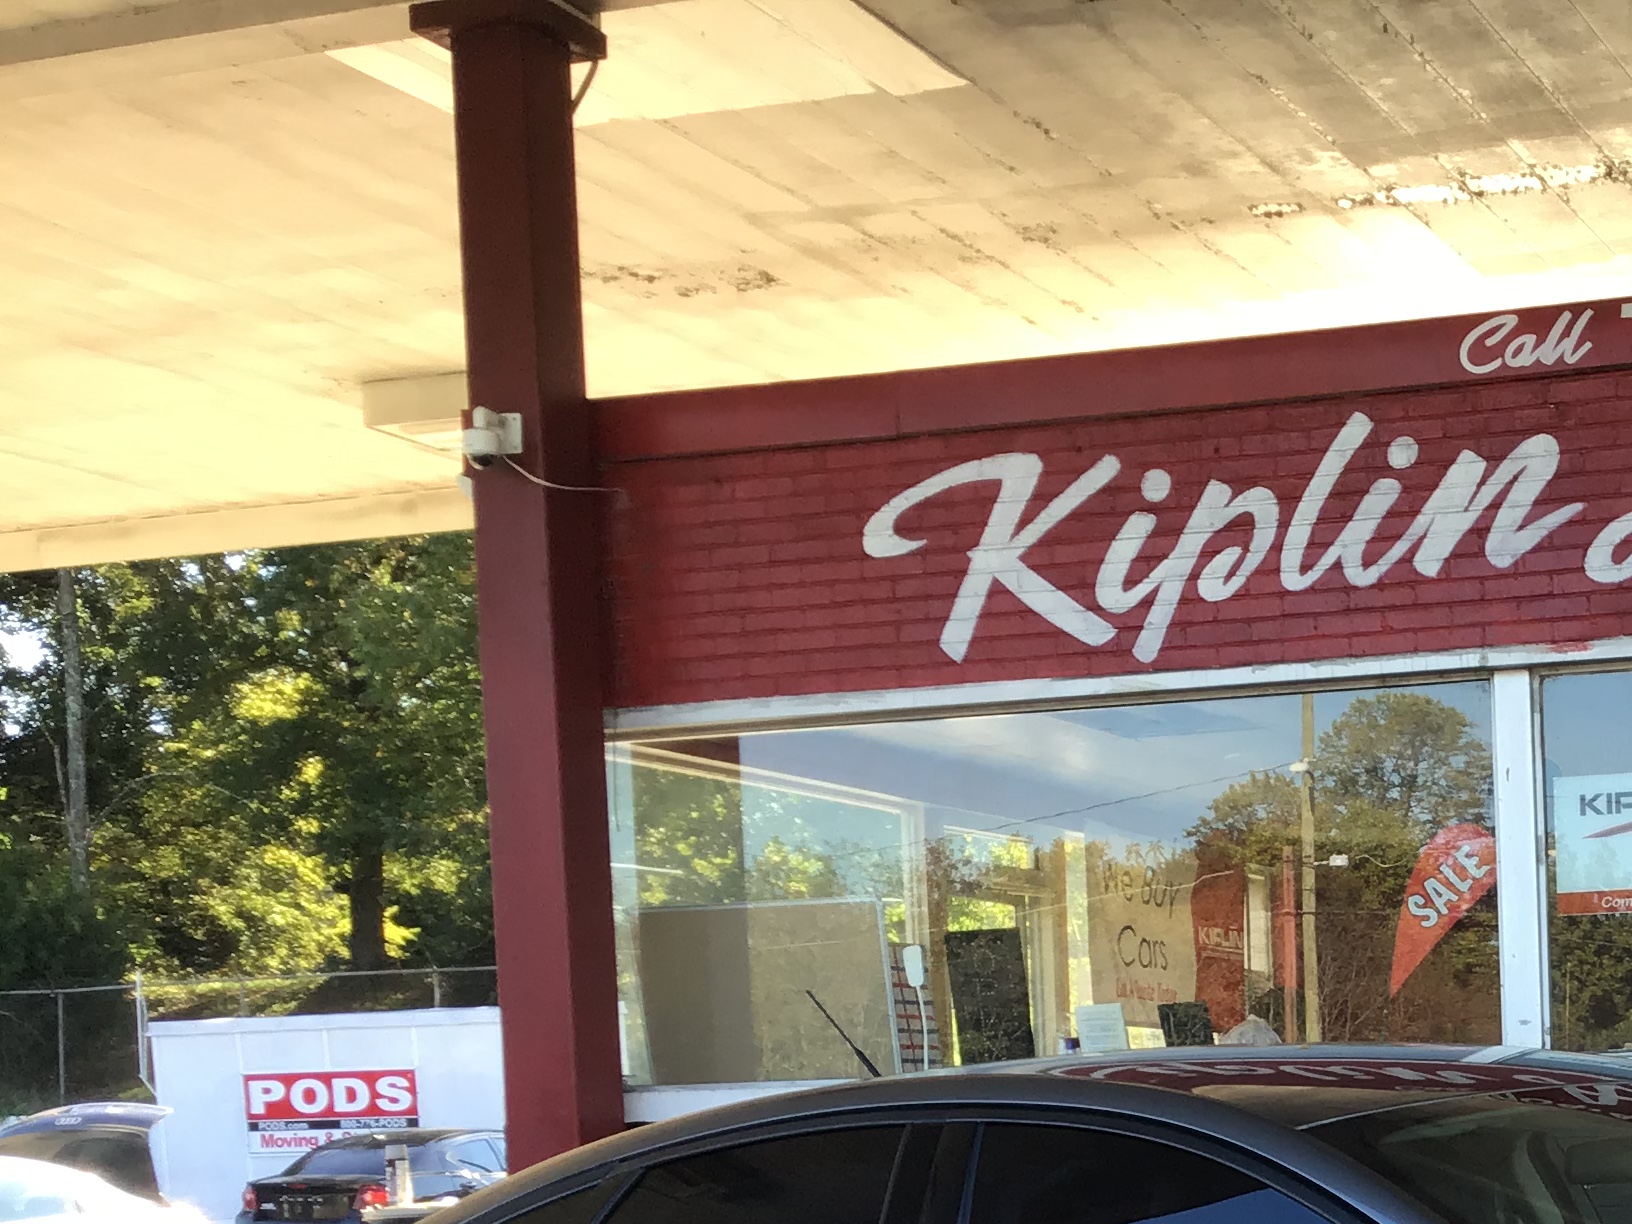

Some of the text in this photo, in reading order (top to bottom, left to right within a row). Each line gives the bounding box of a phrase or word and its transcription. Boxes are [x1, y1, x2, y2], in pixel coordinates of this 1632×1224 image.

[1459, 307, 1594, 374] Call
[862, 410, 1587, 663] Kiplin
[1407, 844, 1492, 928] SALE
[1117, 925, 1169, 971] Cars
[247, 1075, 413, 1115] PODS
[260, 1133, 319, 1149] Moving
